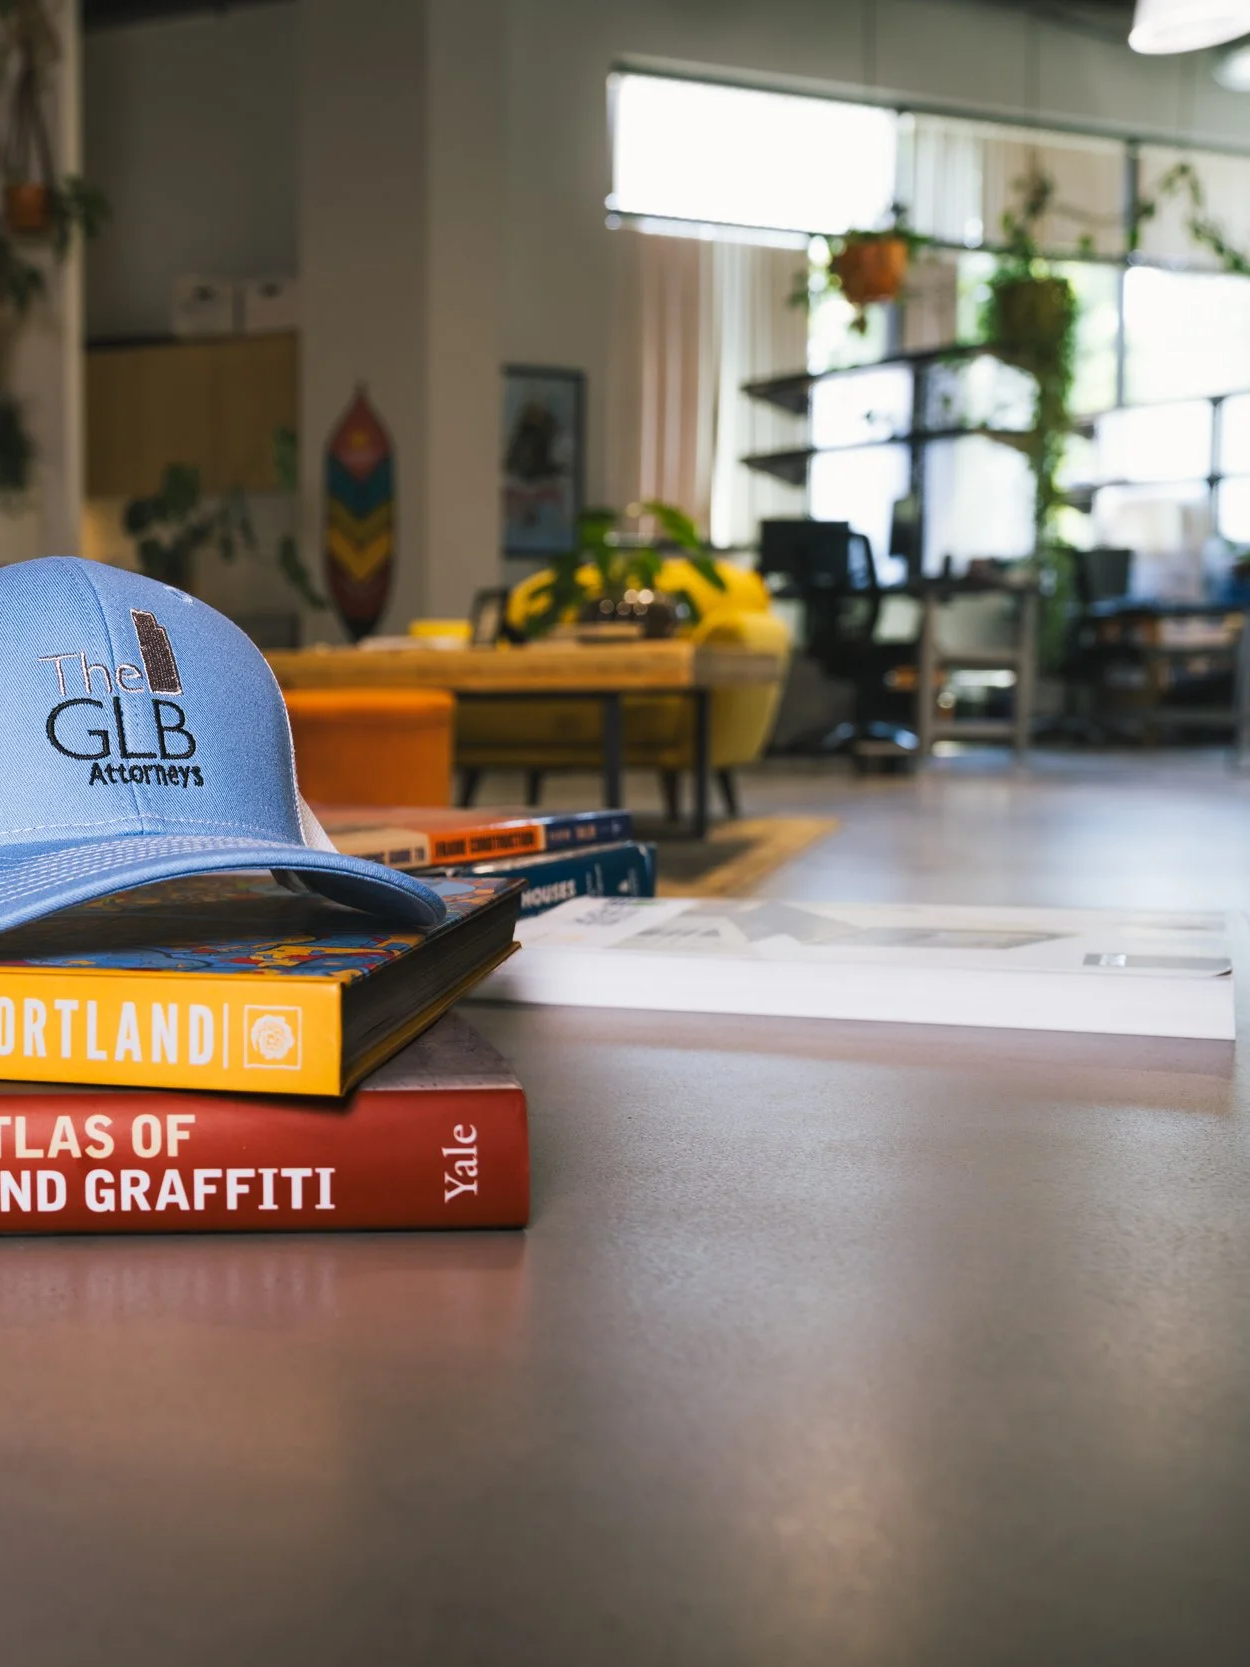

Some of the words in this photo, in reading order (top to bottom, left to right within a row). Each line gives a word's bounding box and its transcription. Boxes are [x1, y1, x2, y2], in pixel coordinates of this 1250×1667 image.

[37, 650, 145, 696] The
[46, 697, 196, 760] GLB
[89, 762, 204, 787] Attorneys
[521, 878, 576, 908] HOUSES
[131, 1114, 196, 1158] OF
[441, 1123, 479, 1203] Yale
[85, 1167, 336, 1212] GRAFFITI
